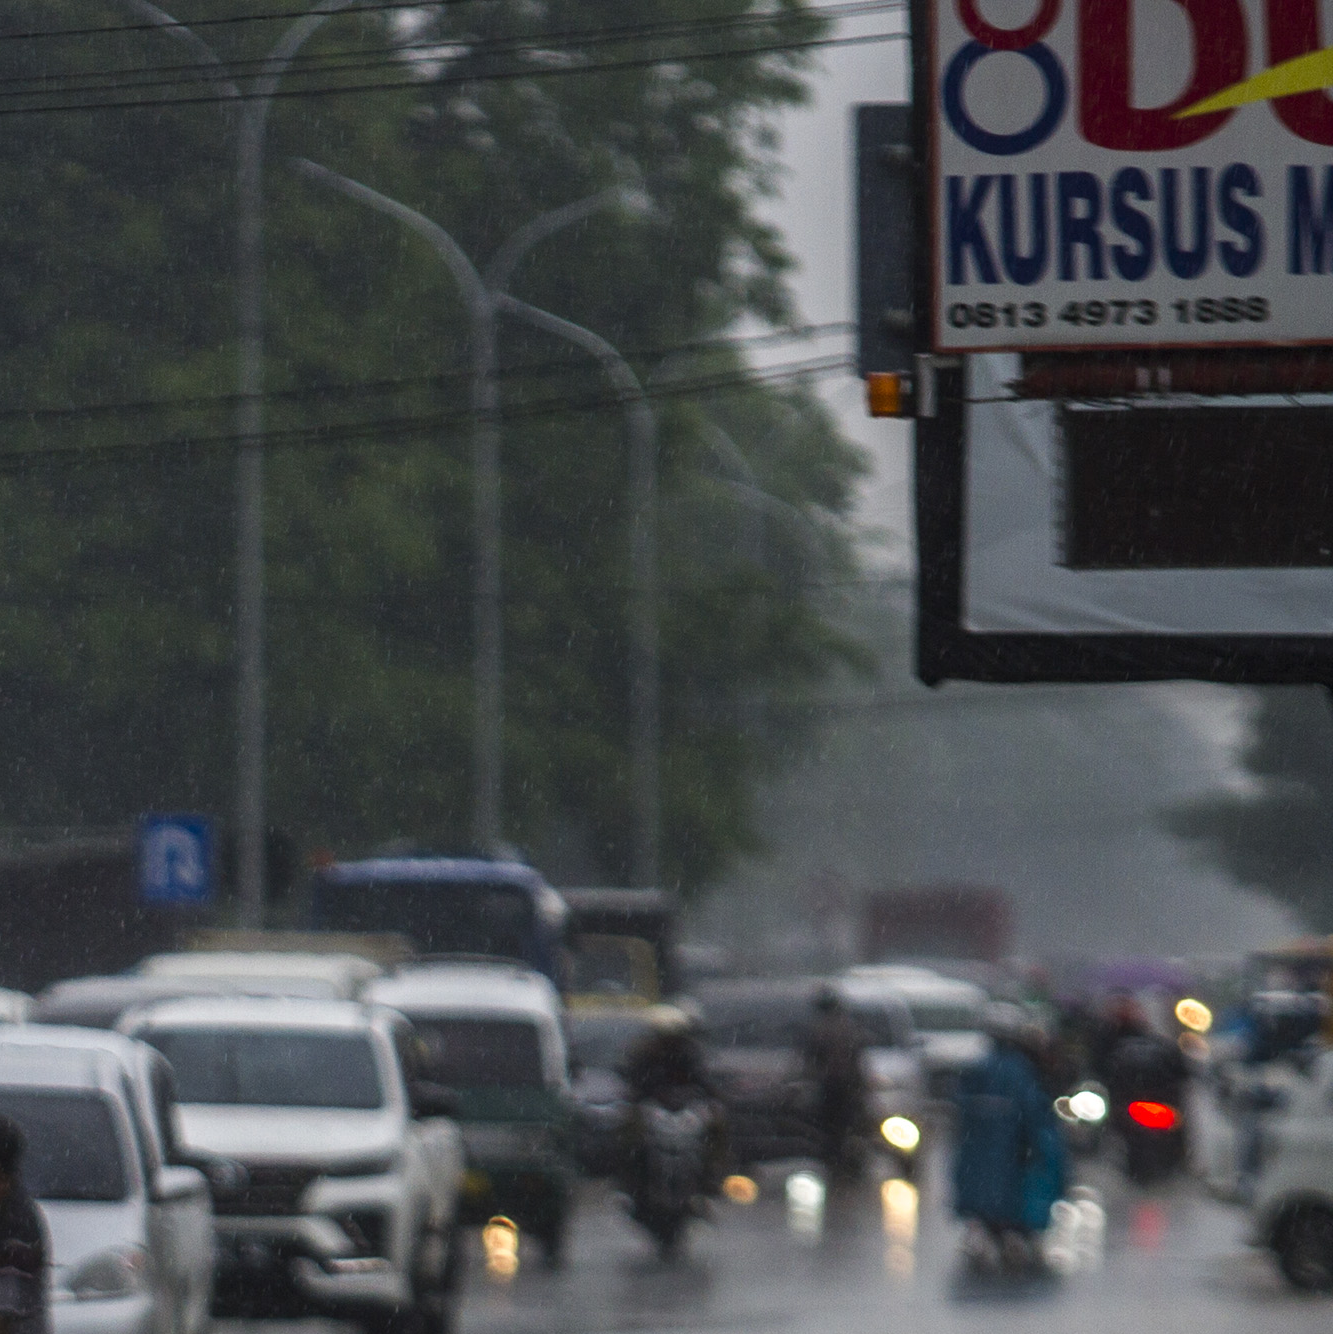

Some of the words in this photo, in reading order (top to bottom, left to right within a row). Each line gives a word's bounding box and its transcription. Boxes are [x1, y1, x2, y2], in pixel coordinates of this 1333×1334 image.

[945, 162, 1267, 286] KURSUS
[947, 302, 1047, 328] 0813
[1057, 300, 1159, 326] 4973
[1172, 297, 1269, 323] 1888
